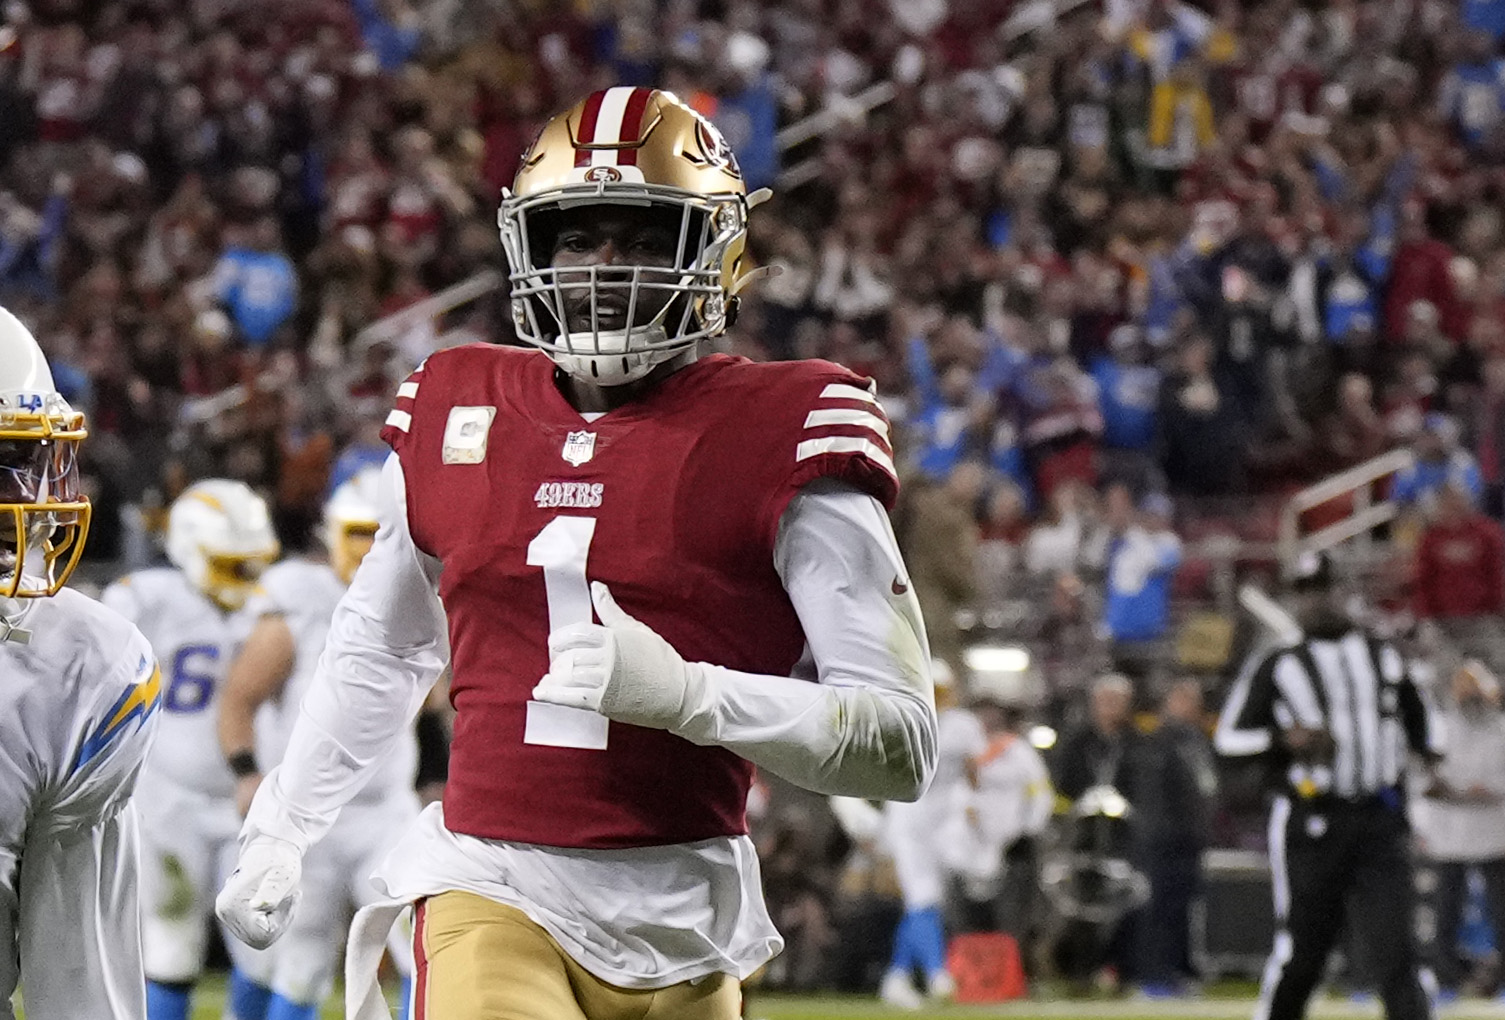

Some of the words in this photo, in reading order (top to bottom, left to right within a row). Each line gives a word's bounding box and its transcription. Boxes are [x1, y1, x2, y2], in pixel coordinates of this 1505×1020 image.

[534, 482, 604, 508] 49ERS
[524, 516, 610, 751] 1
[163, 643, 238, 715] 6
